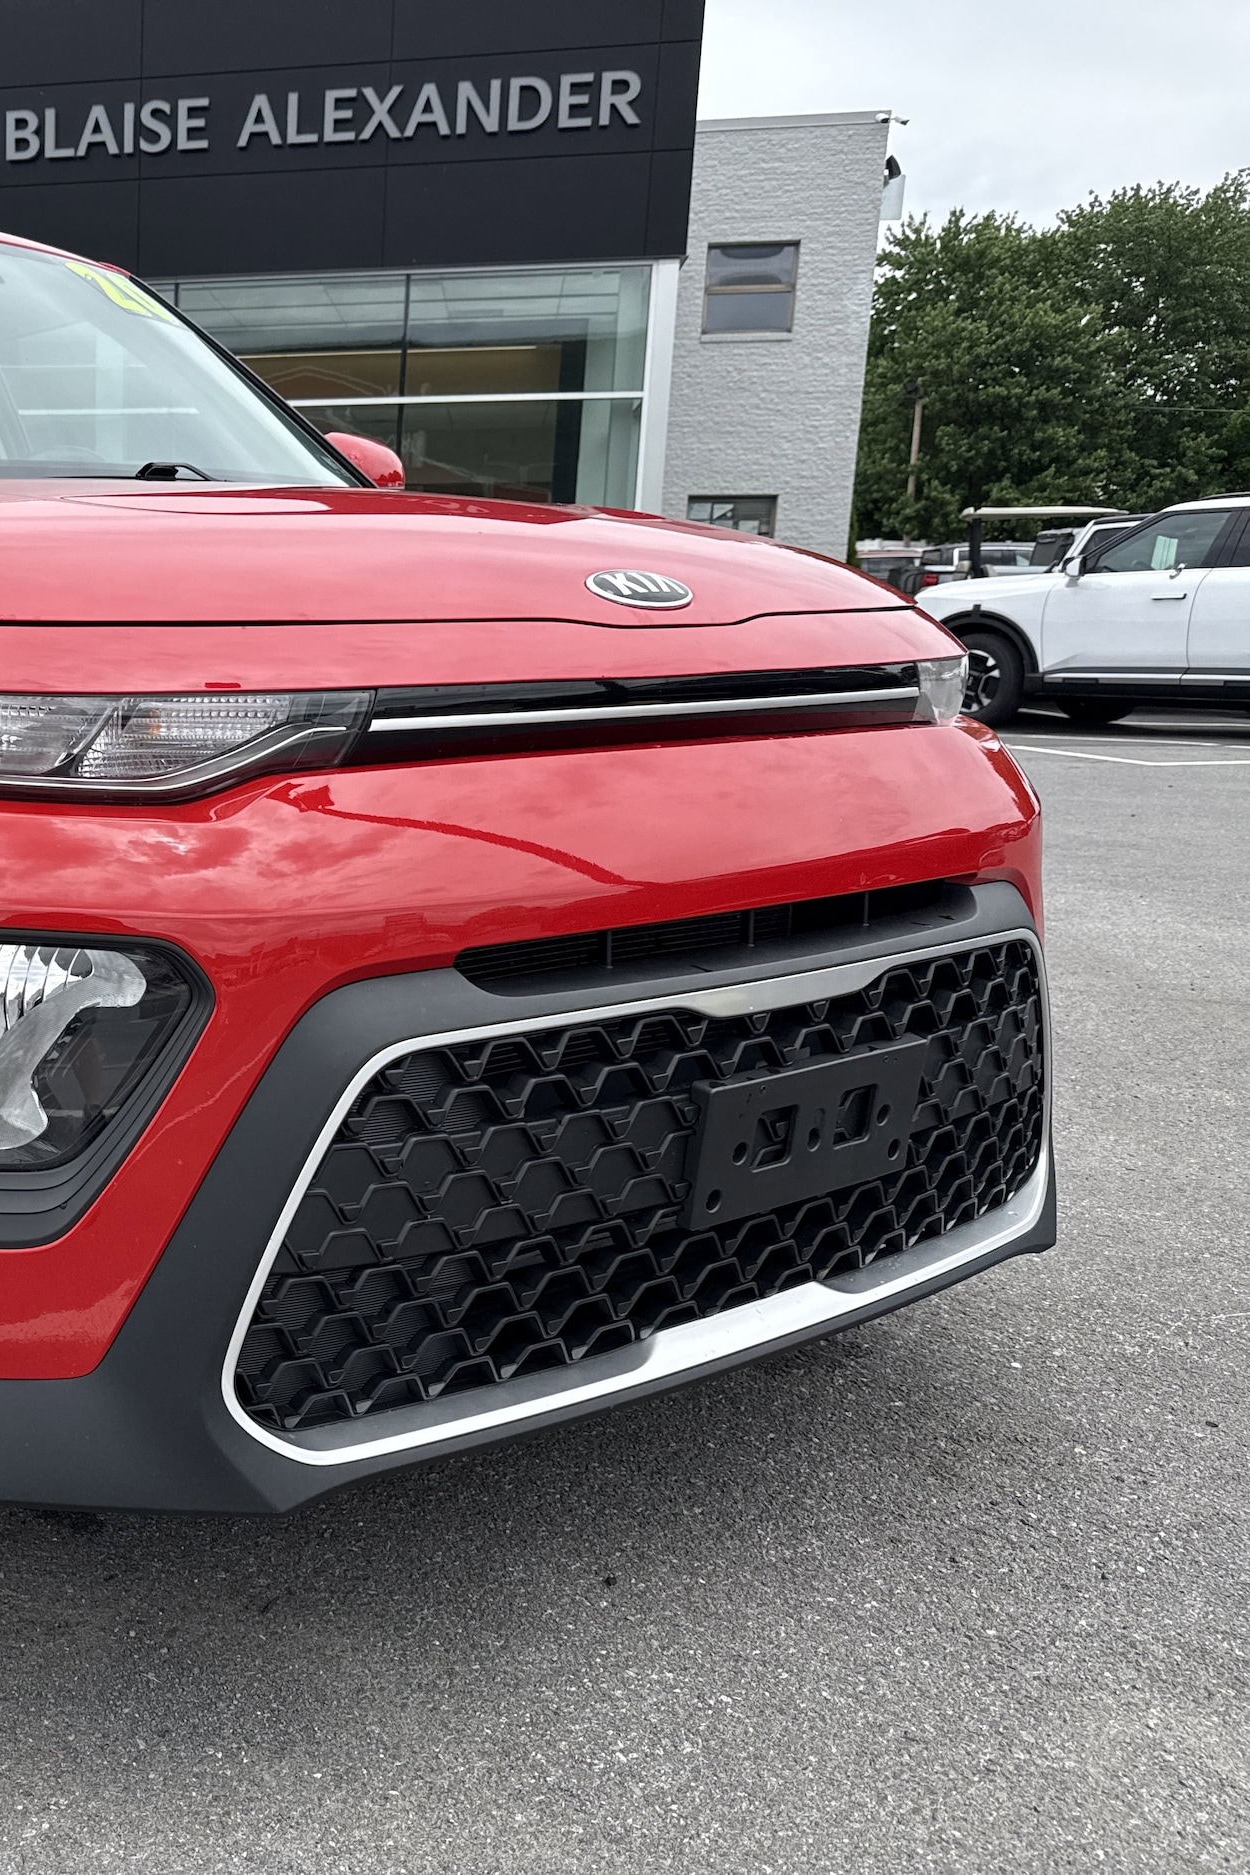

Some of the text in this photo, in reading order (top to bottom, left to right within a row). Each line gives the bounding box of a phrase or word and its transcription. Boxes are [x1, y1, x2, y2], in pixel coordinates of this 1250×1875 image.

[5, 70, 643, 162] BLAISE ALEXANDER
[600, 572, 685, 596] KIA
